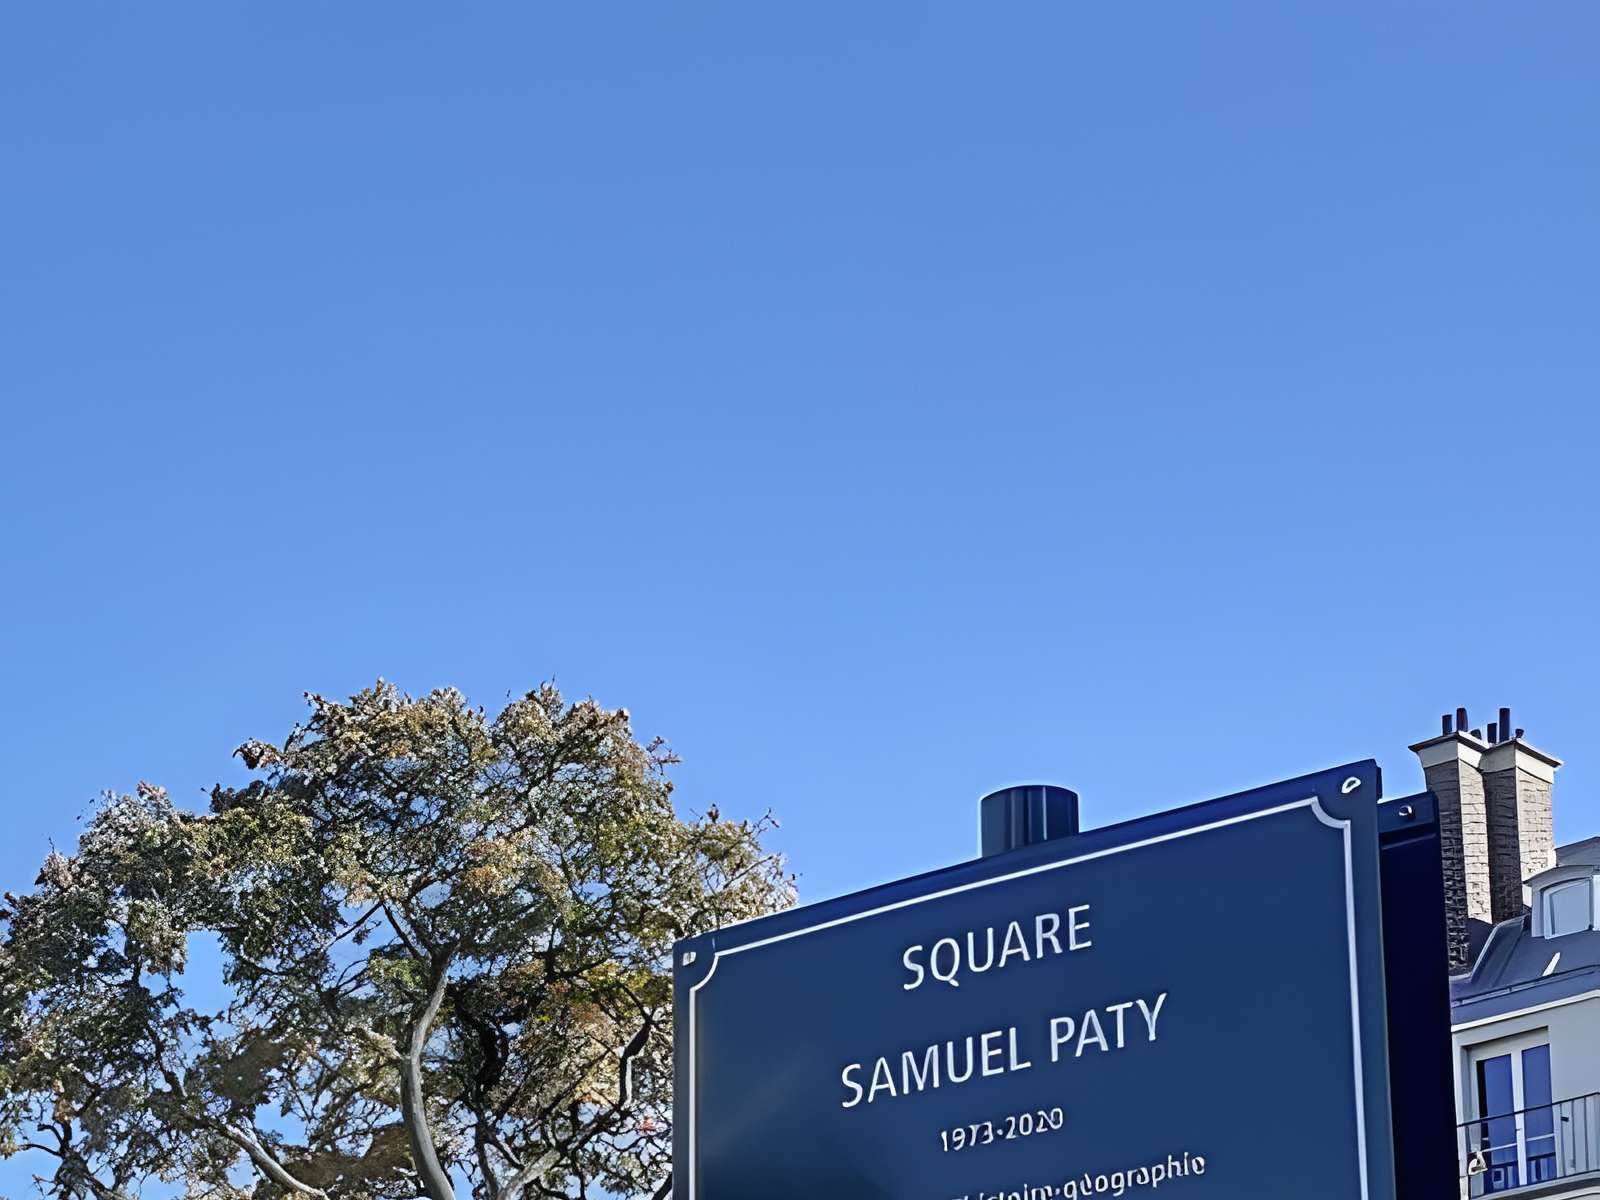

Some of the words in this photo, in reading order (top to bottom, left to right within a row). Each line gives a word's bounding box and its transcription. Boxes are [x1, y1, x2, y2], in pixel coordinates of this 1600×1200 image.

[902, 903, 1093, 992] SQUARE
[840, 1026, 1033, 1109] SAMUEL
[1049, 991, 1169, 1064] PATY
[939, 1107, 1065, 1153] 1973-2020
